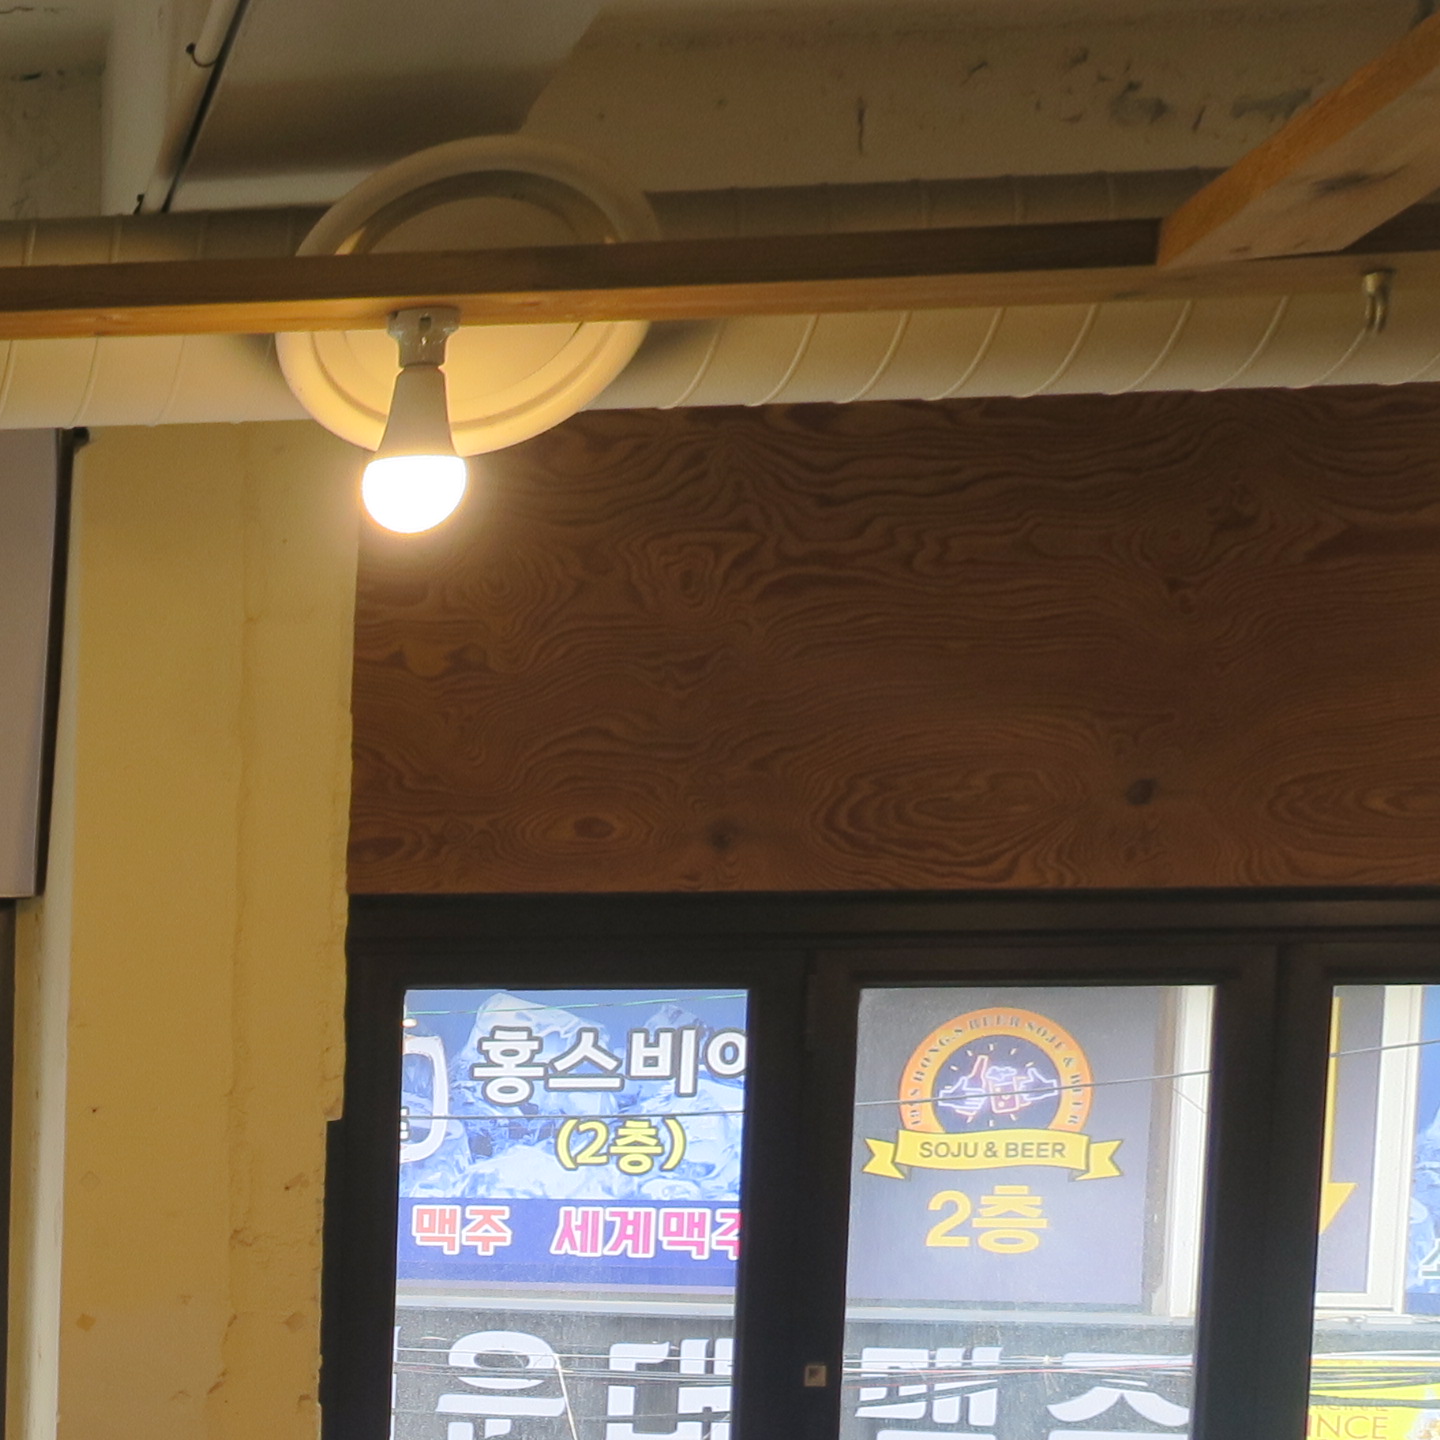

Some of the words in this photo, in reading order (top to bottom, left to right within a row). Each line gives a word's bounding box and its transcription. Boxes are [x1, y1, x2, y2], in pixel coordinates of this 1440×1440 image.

[556, 1118, 686, 1174] (2층)
[919, 1141, 979, 1158] SOJU
[983, 1141, 999, 1158] &
[1005, 1141, 1067, 1158] BEER
[413, 1206, 511, 1255] 맥주
[925, 1184, 1050, 1254] 2층
[1306, 1414, 1388, 1440] INCE
